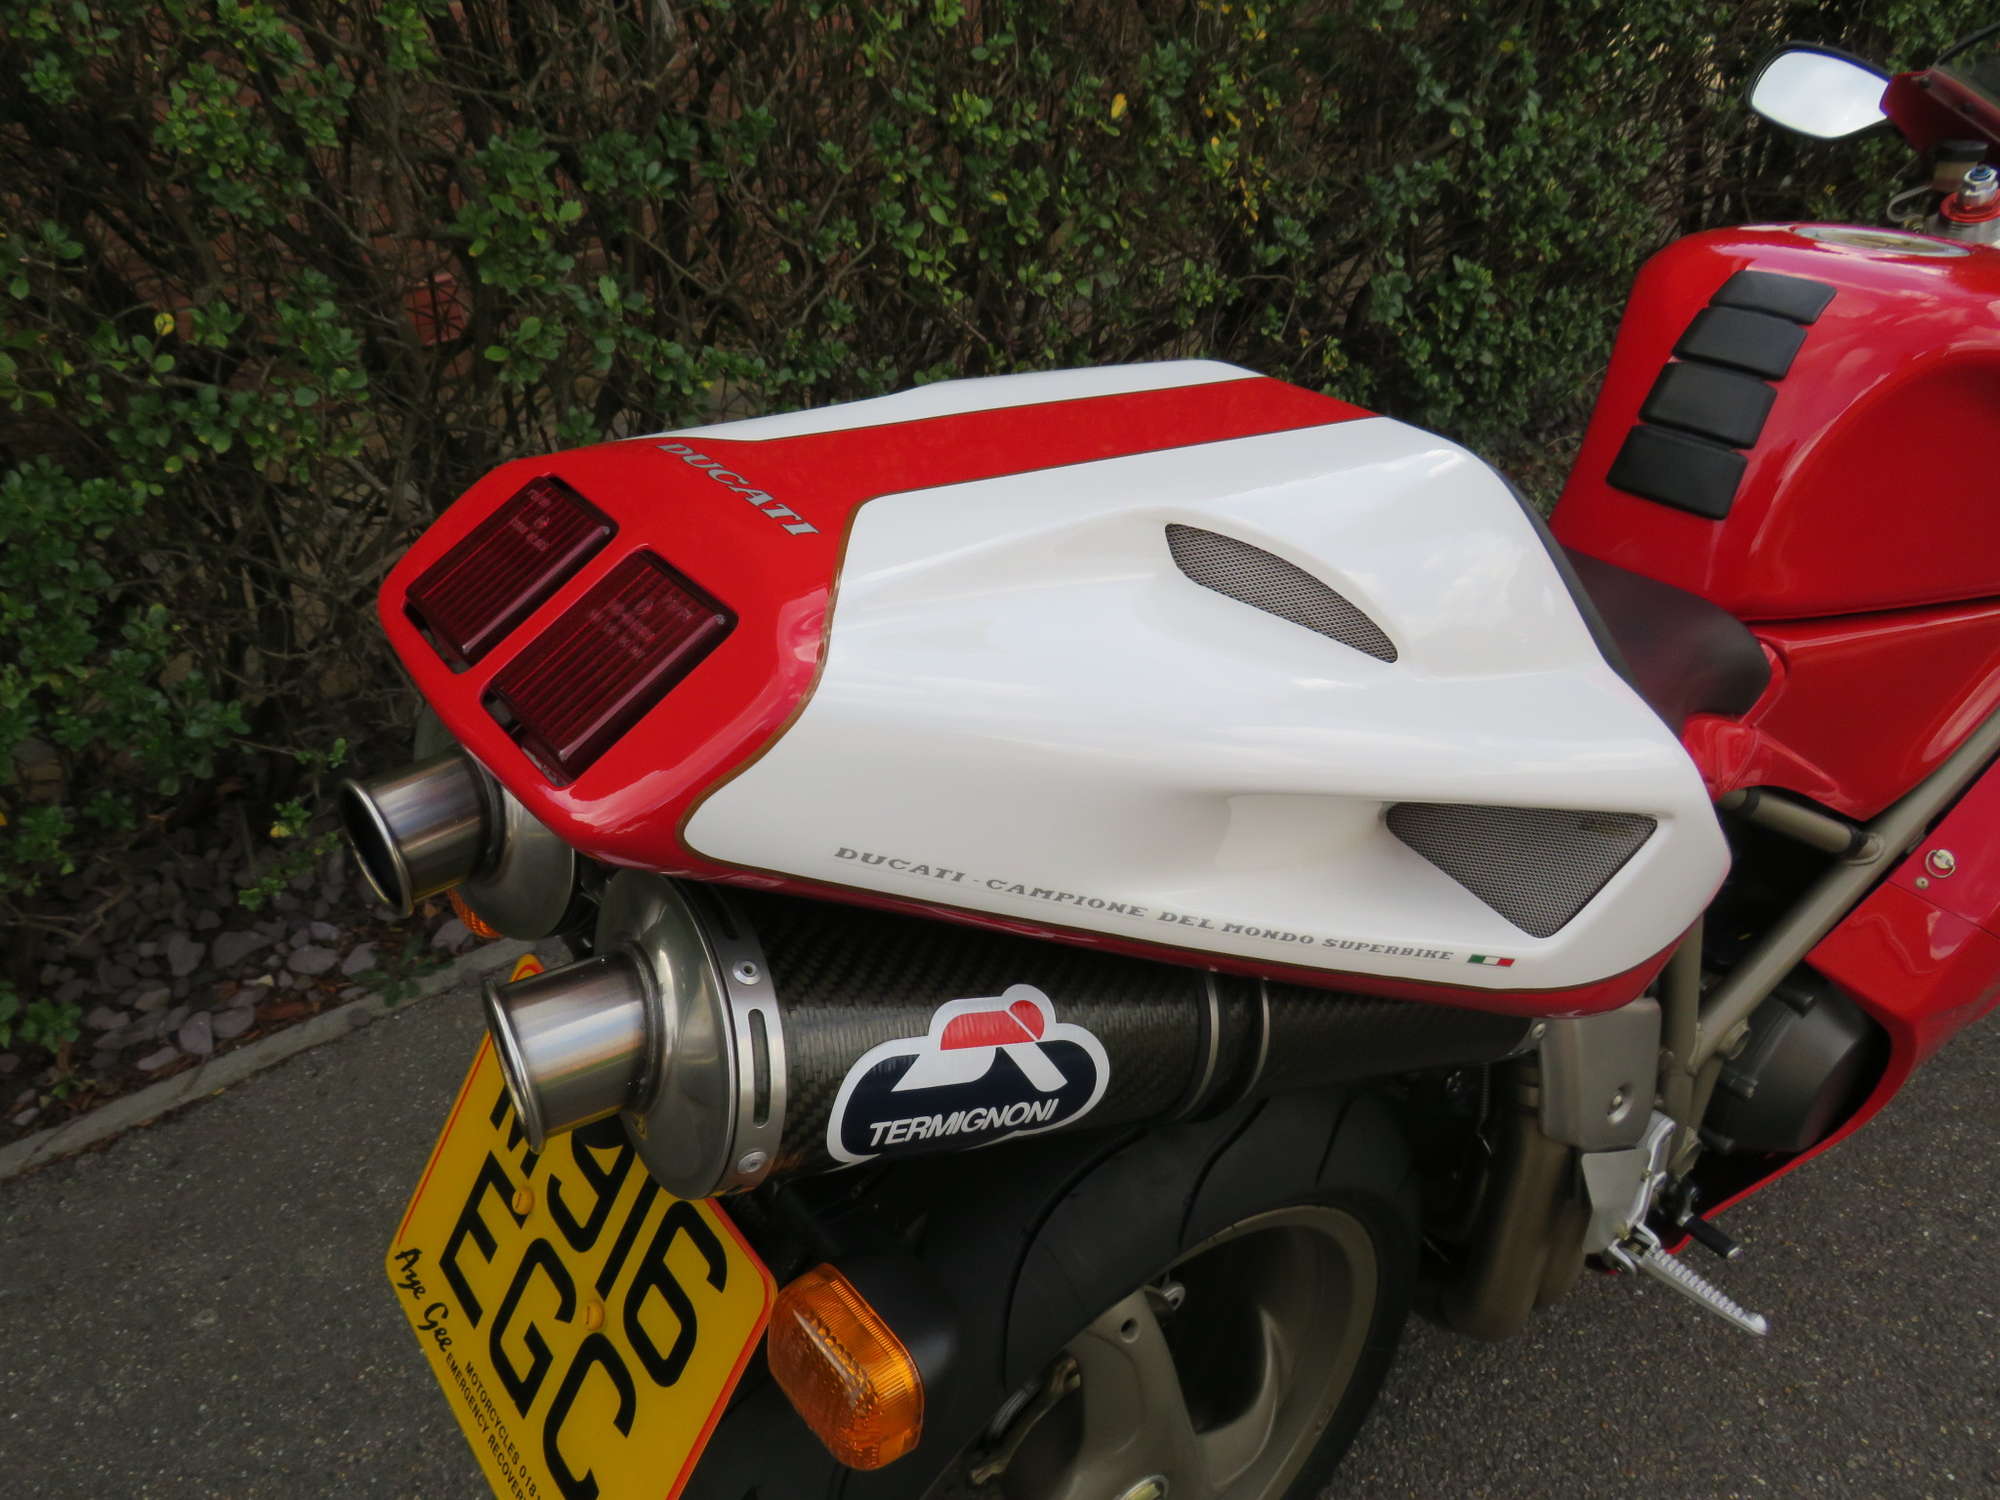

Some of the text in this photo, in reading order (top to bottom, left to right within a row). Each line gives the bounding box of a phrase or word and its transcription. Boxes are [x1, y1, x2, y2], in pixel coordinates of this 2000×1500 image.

[656, 443, 821, 536] DUCATI
[833, 846, 967, 884] DUCATI
[985, 879, 1149, 917] CAMPIONE
[1157, 911, 1215, 930] DEL
[1221, 922, 1316, 945] MONDO
[1322, 937, 1454, 961] SUPERBIKE
[869, 1098, 1060, 1147] TERMIGNONI
[395, 1248, 452, 1353] Aye Gee
[439, 1150, 637, 1500] EGC
[446, 1353, 527, 1500] EMERGENCY RECOVER
[465, 1362, 520, 1465] MOTORCYCLES
